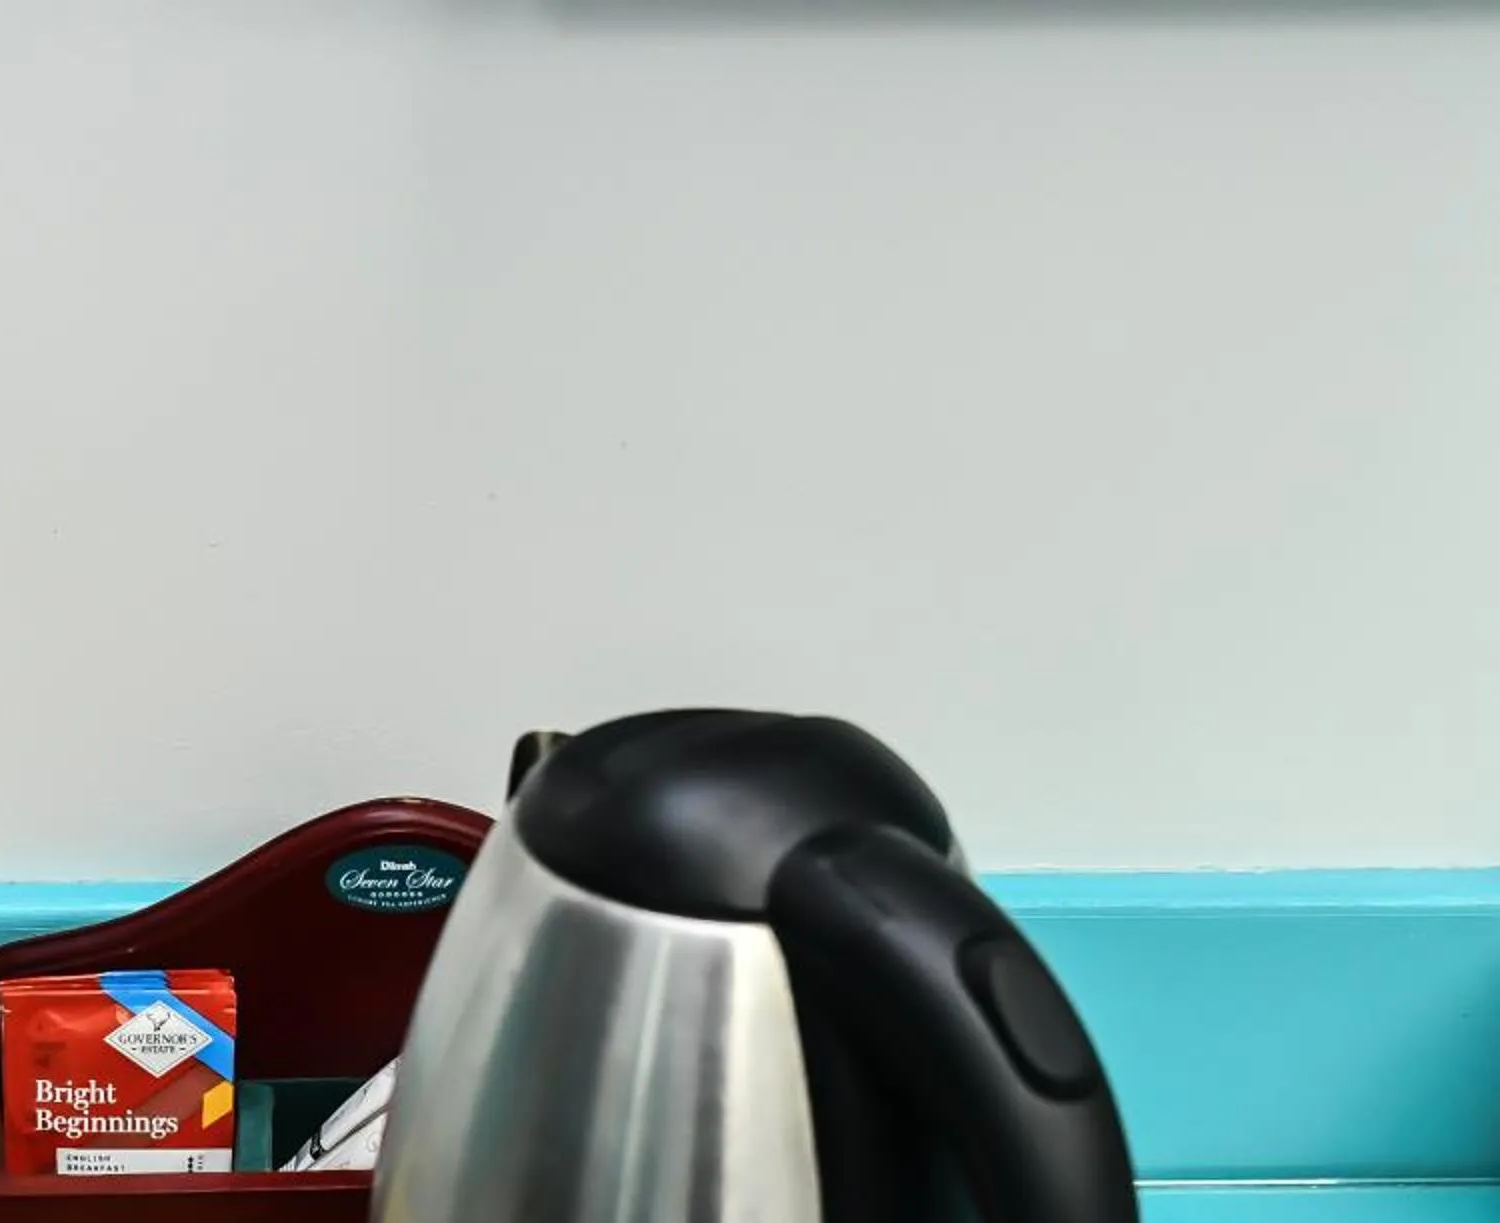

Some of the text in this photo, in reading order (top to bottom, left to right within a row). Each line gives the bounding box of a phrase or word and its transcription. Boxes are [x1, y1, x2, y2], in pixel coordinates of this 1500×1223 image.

[339, 866, 455, 891] Seven Star
[118, 1033, 197, 1045] GOVERNOR'S
[35, 1079, 117, 1111] Bright
[35, 1109, 179, 1139] Beginnings
